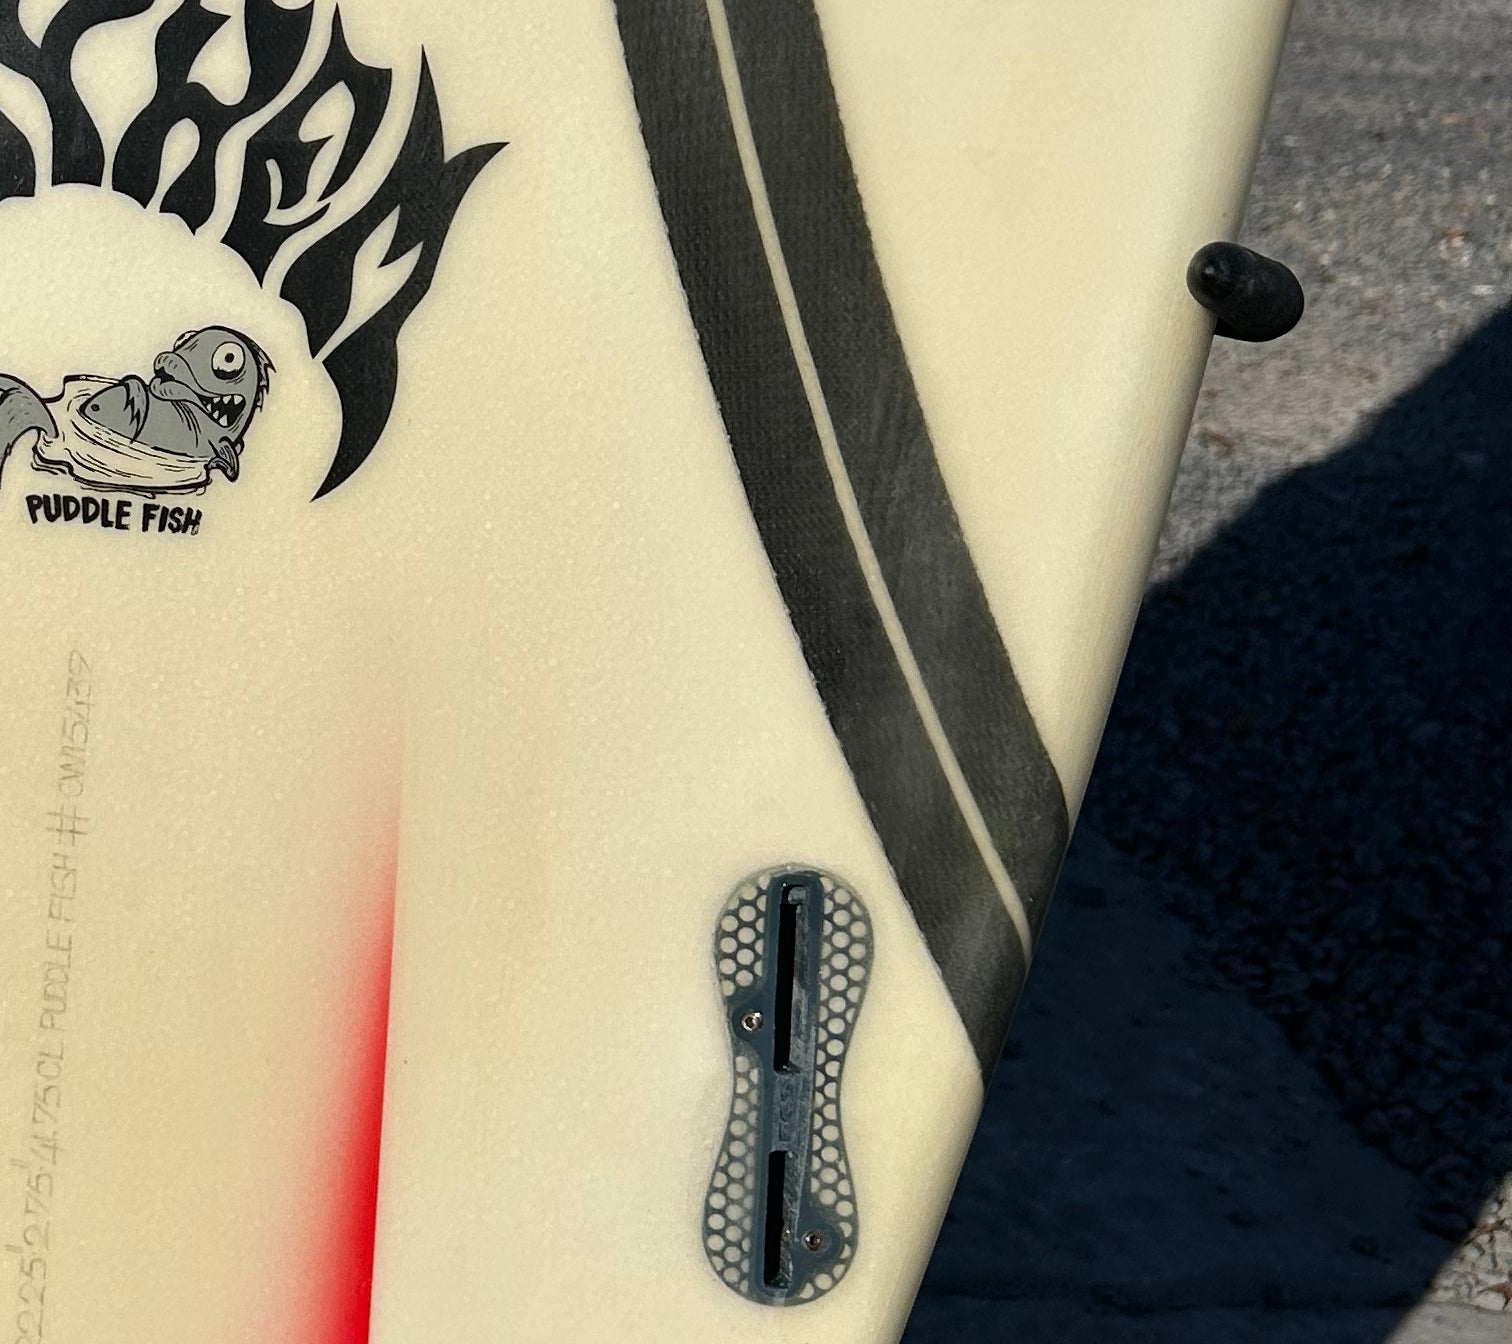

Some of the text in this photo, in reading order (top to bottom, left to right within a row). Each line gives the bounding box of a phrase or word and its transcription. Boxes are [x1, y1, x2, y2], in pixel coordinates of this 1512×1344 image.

[25, 493, 203, 536] PUDDLE FISH
[48, 851, 78, 923] FISH
